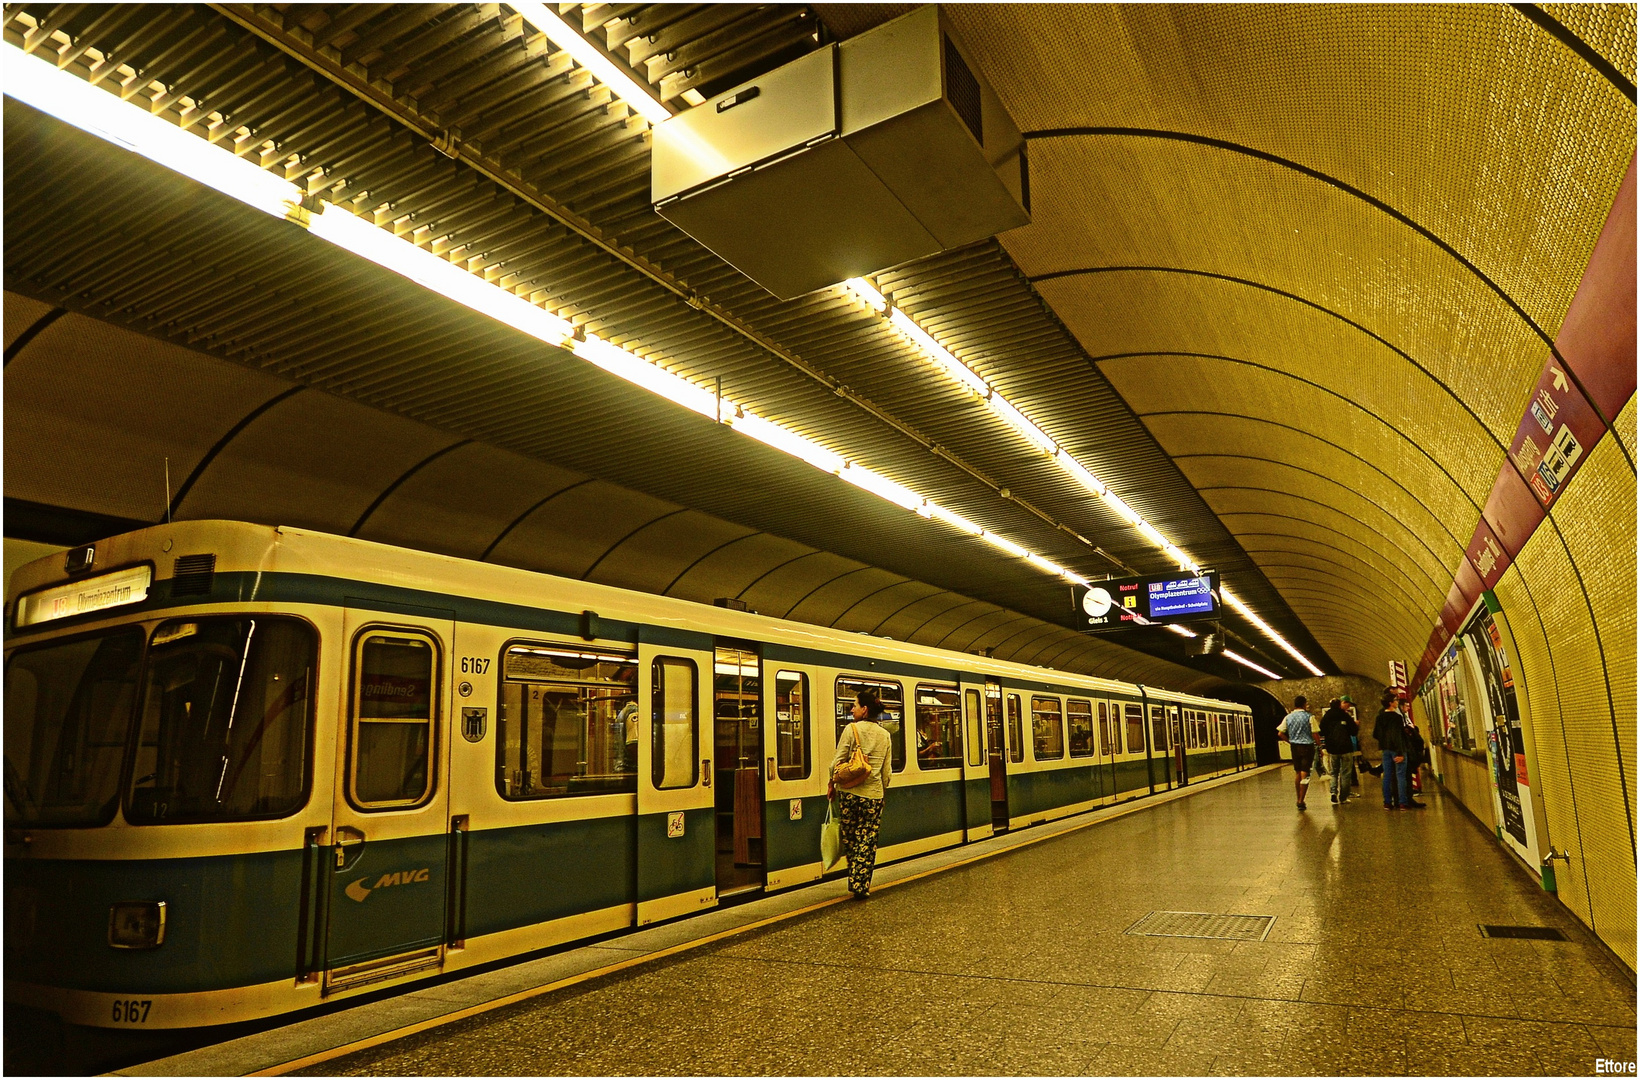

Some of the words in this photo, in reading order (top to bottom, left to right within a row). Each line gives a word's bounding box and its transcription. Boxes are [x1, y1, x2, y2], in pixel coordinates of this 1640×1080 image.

[1537, 389, 1559, 420] Lift
[1512, 435, 1541, 474] Ausgang
[1533, 476, 1550, 501] U3
[1150, 590, 1197, 600] Olympiazentrum
[461, 657, 490, 674] 6167
[532, 690, 539, 699] 2
[373, 868, 429, 889] MVG
[112, 1000, 152, 1023] 6167
